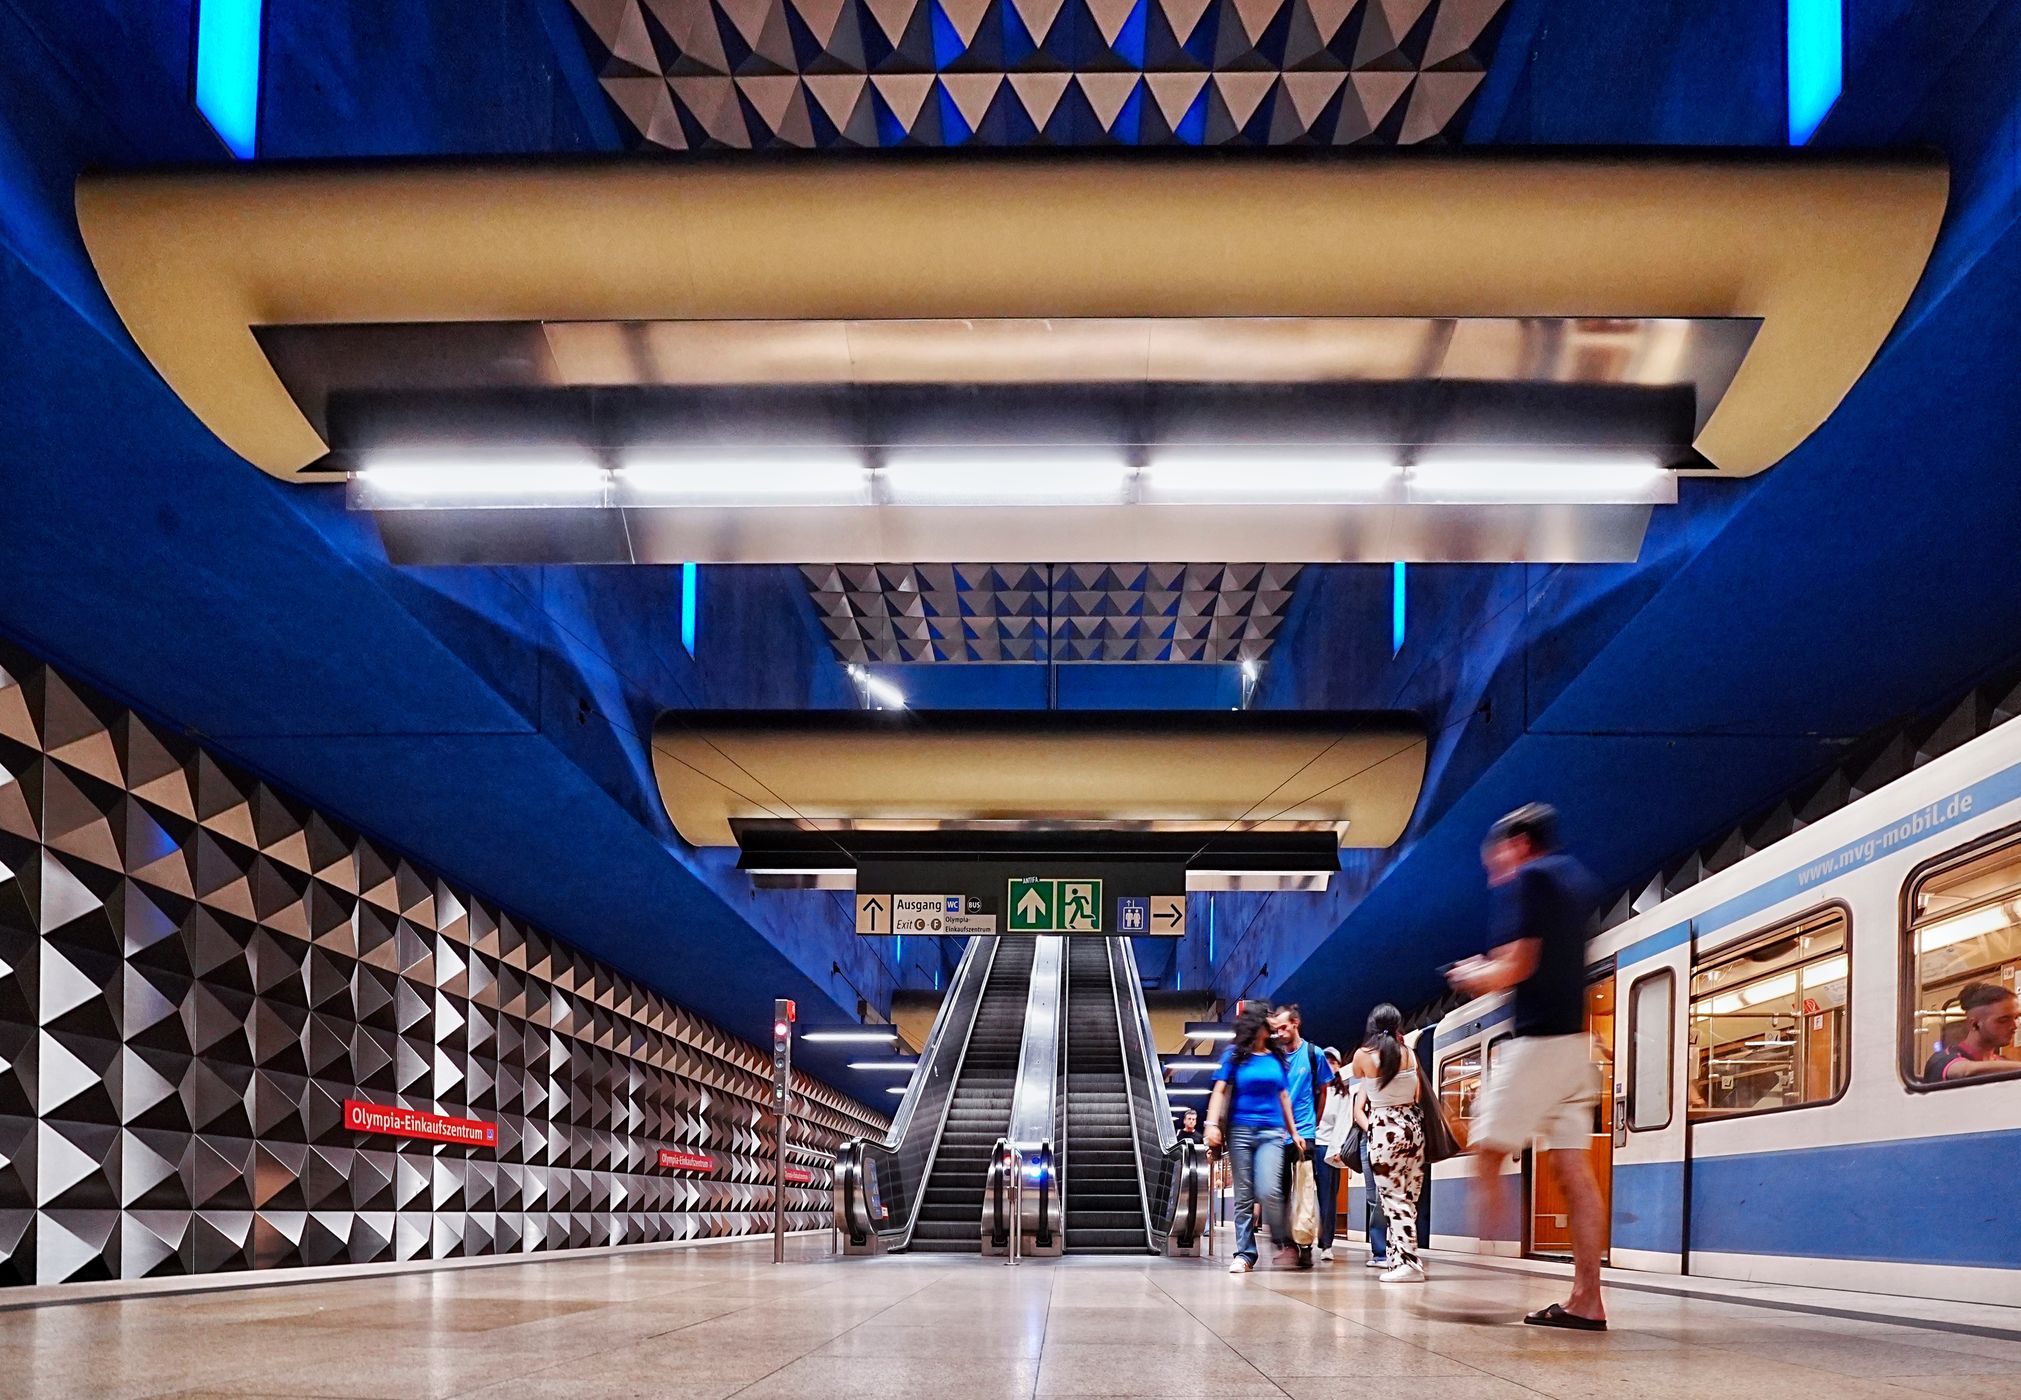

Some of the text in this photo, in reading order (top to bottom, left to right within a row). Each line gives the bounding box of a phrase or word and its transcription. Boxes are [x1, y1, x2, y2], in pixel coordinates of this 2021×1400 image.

[1798, 792, 1973, 886] www.mvg-mobil.de
[897, 899, 942, 912] Ausgang
[947, 900, 959, 909] WC
[896, 919, 912, 930] Exit
[352, 1107, 483, 1141] Olympia-Einkaufszentrum
